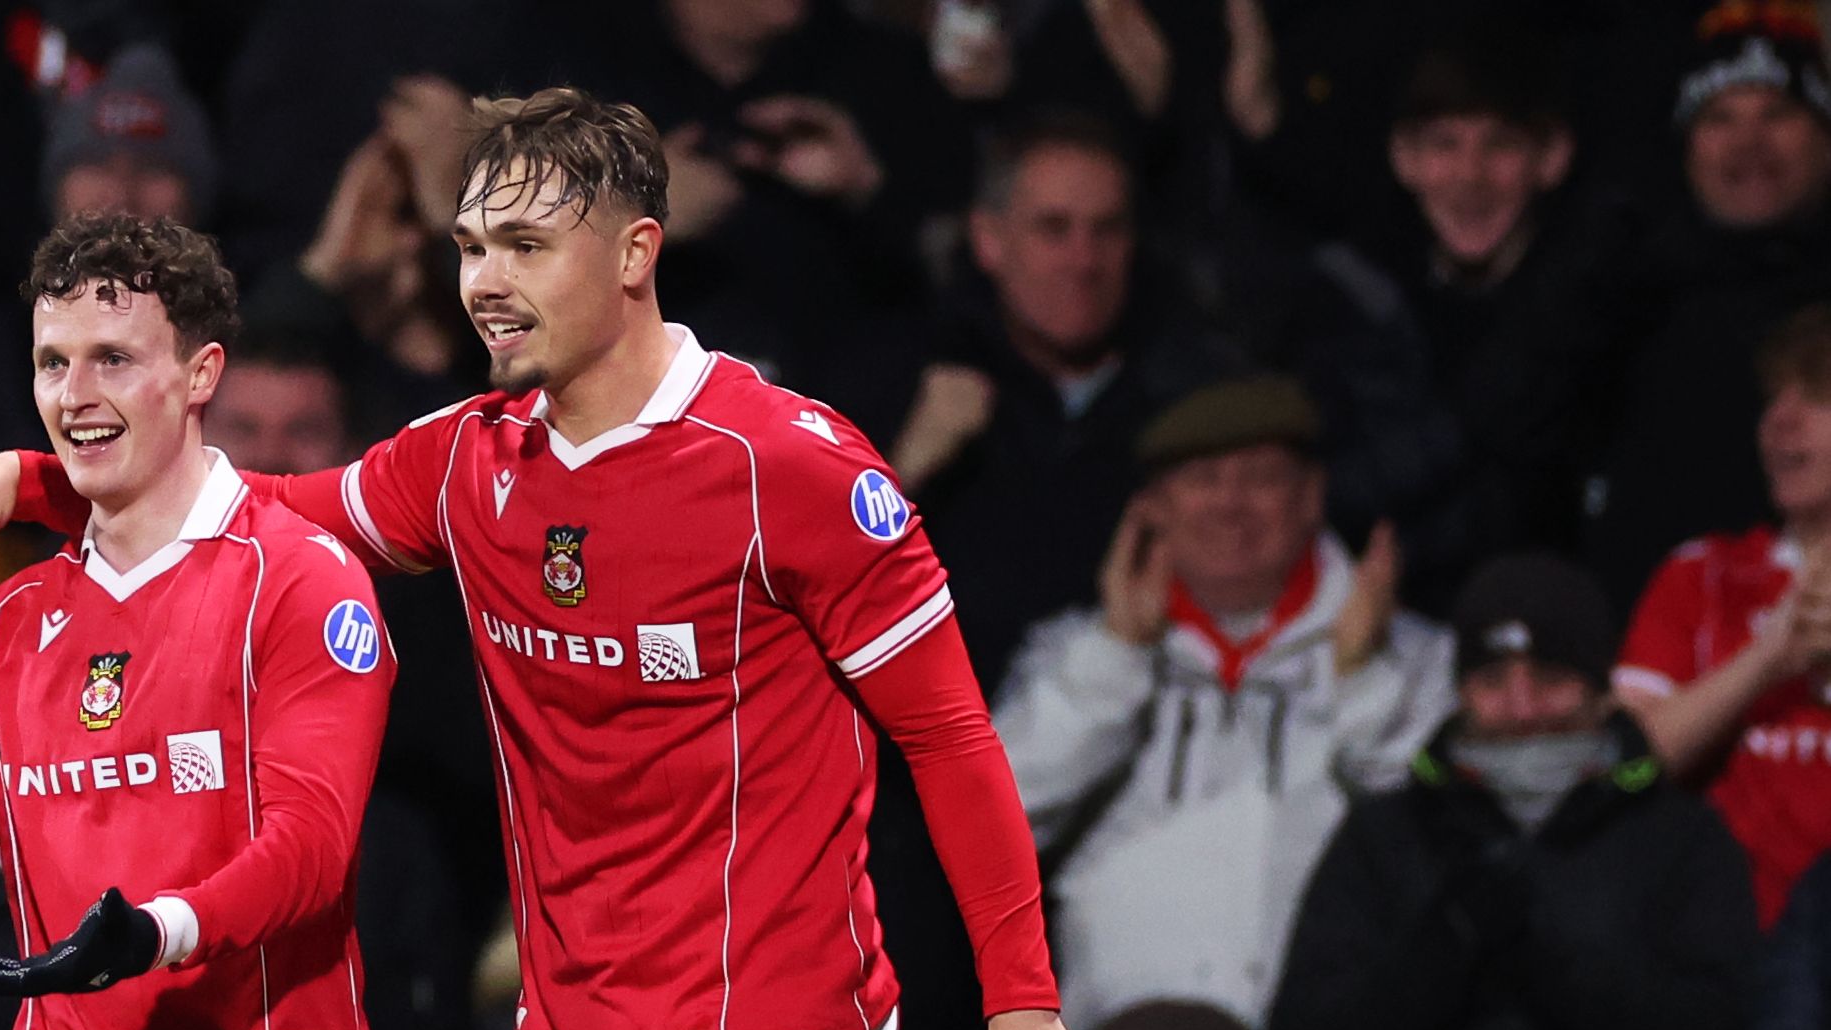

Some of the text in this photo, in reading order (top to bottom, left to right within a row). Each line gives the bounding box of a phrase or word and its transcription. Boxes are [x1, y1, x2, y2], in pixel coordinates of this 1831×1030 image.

[858, 472, 901, 538] hp
[333, 600, 375, 671] hp
[481, 610, 625, 667] UNITED
